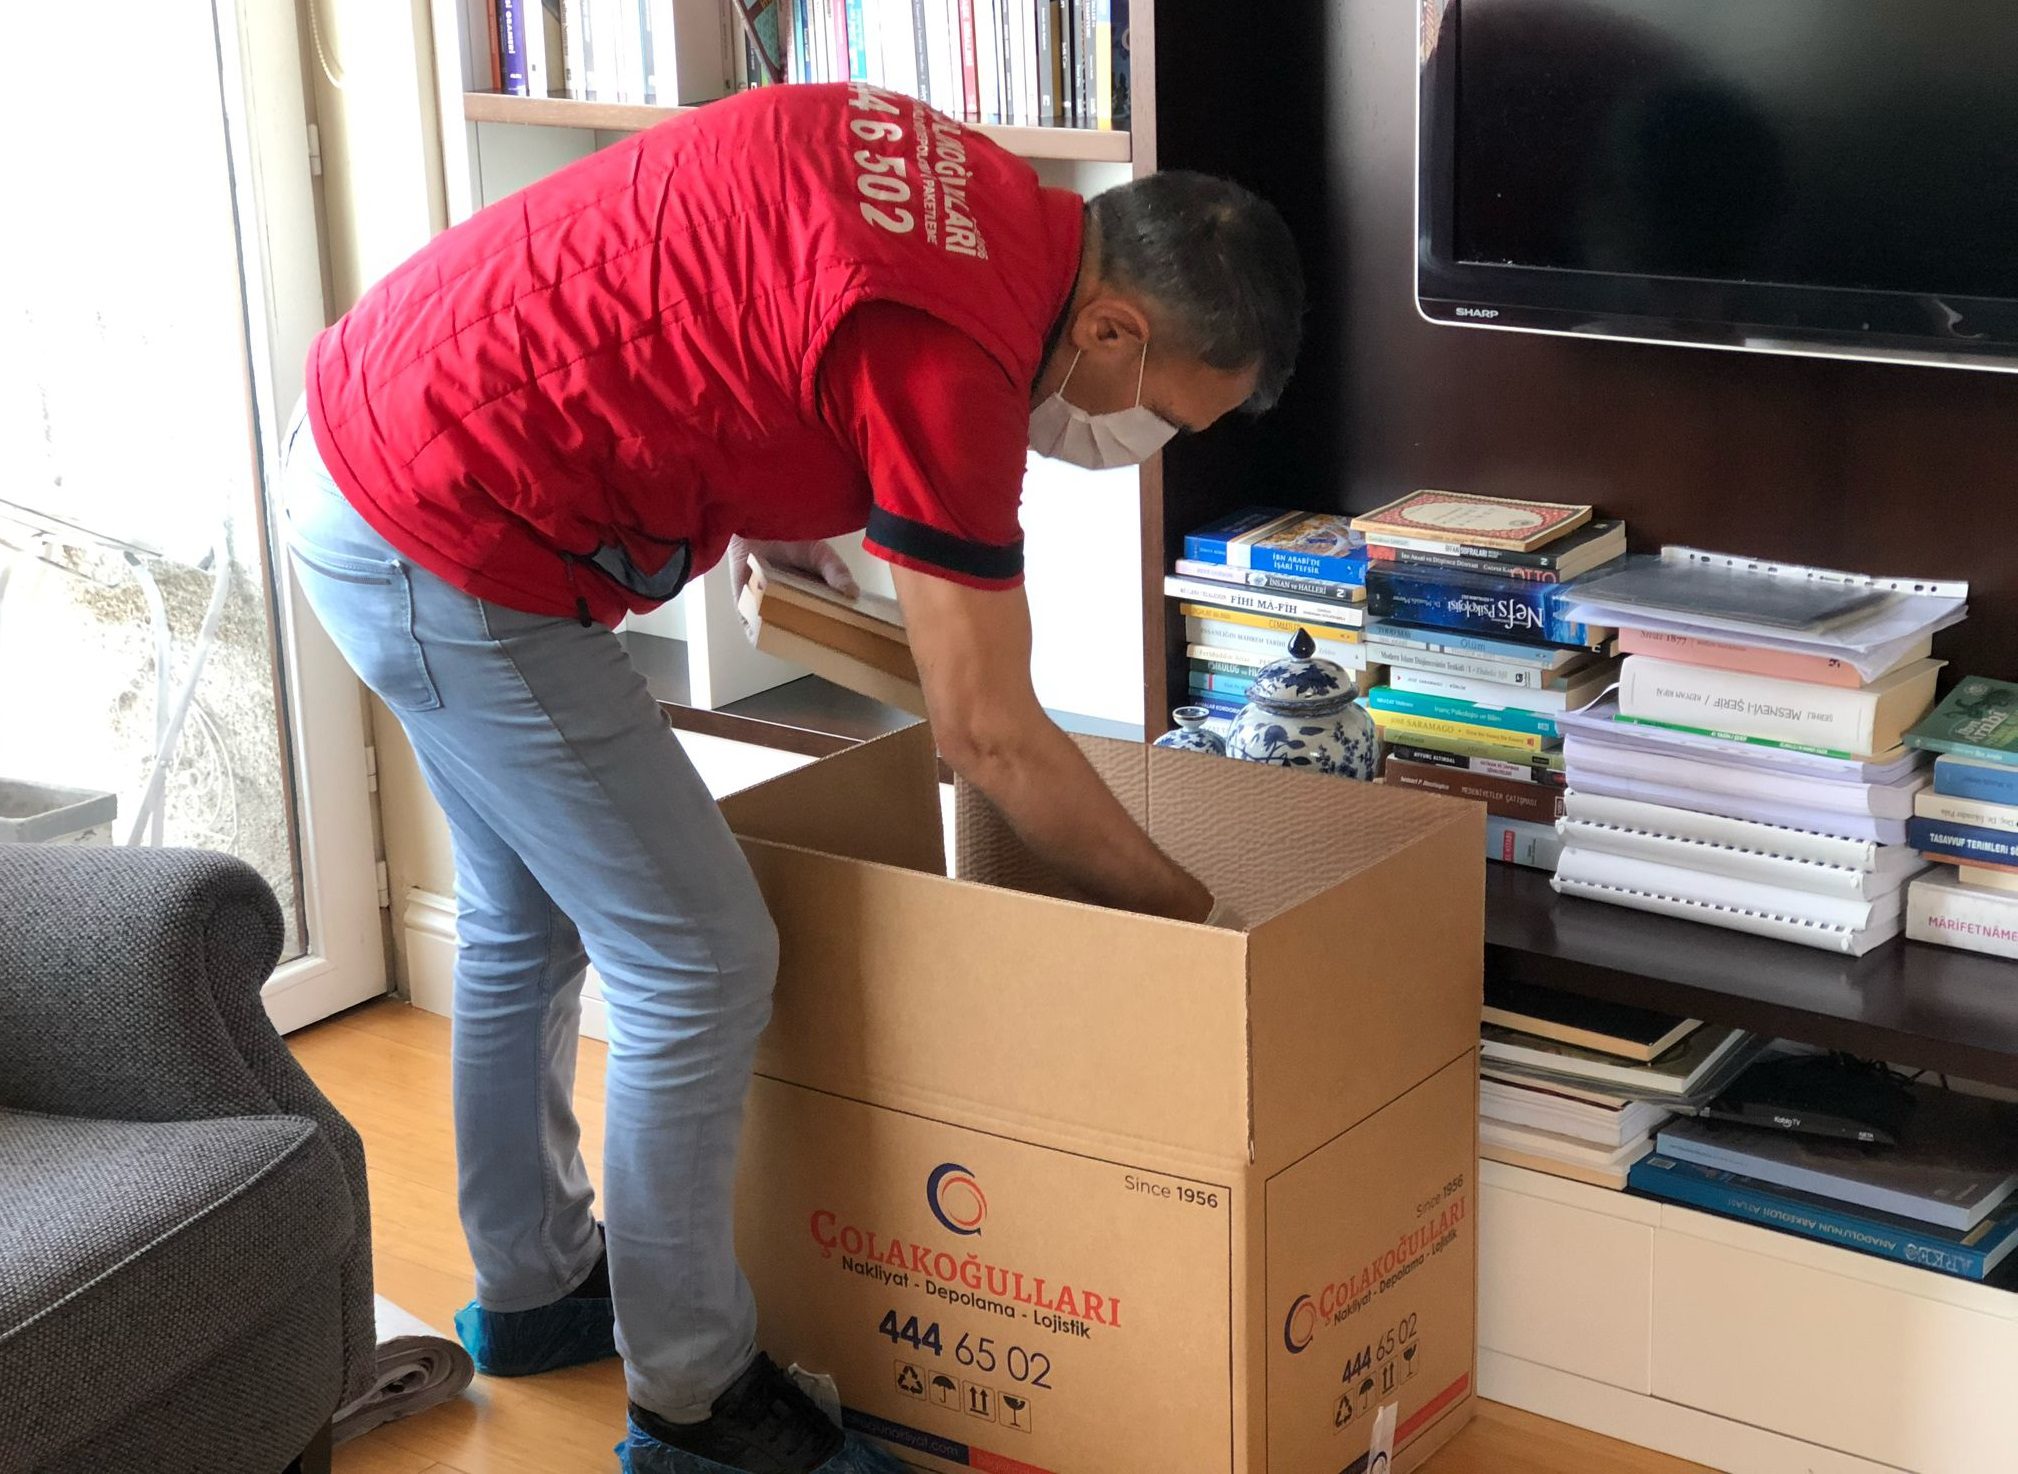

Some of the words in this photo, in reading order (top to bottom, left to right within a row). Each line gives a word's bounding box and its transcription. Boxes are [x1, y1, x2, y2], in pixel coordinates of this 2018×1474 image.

[850, 118, 903, 142] 6
[853, 150, 915, 234] 502
[1455, 307, 1499, 319] SHARP
[1448, 600, 1496, 618] Psikolojisi
[1499, 599, 1544, 630] Nefs
[1406, 718, 1455, 734] SARAMAGO
[1930, 833, 1965, 847] TASAVVUF
[1124, 1175, 1172, 1200] Since
[1176, 1186, 1219, 1209] 1956
[1443, 1173, 1464, 1200] 1956
[810, 1209, 1122, 1328] ÇOLAKOĞULLARI
[1318, 1198, 1466, 1327] ÇOLAKOĞULLARI
[842, 1255, 910, 1290] Nakliyat
[925, 1280, 1016, 1320] Depolama
[1033, 1310, 1092, 1340] Lojistik
[1333, 1293, 1372, 1326] Nakliyat
[1379, 1255, 1425, 1294] Depolama
[878, 1309, 943, 1357] 444
[955, 1332, 996, 1372] 65
[1008, 1346, 1052, 1390] 02
[1341, 1345, 1372, 1384] 444
[1376, 1328, 1395, 1362] 65
[1398, 1312, 1418, 1345] 02
